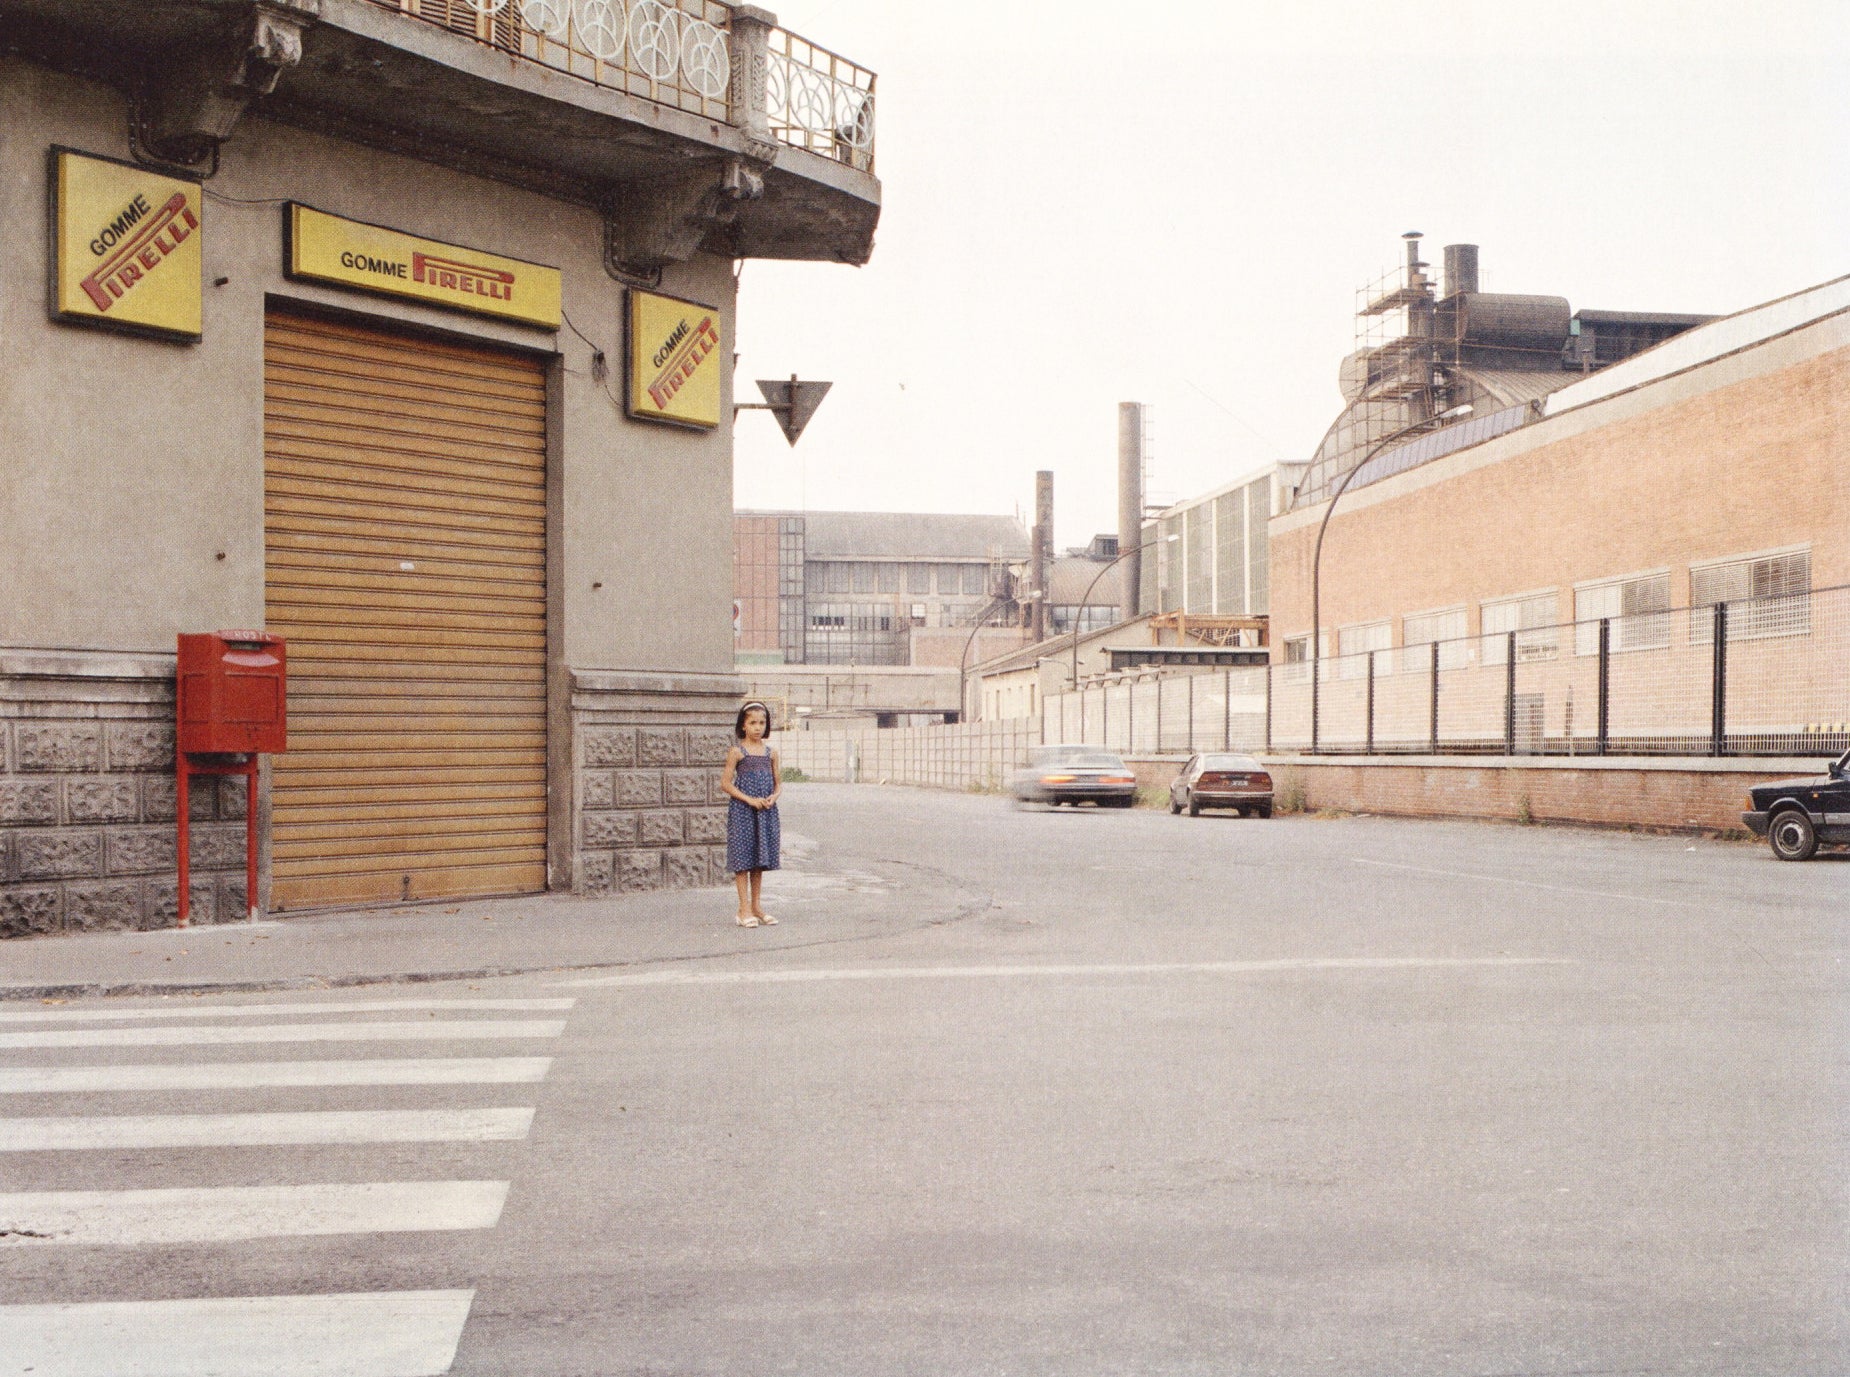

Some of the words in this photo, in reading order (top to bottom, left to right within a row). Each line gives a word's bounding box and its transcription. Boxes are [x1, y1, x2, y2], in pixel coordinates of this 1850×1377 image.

[80, 192, 199, 312] PIRELLI
[90, 193, 151, 257] GOMME
[341, 251, 407, 279] GOMME
[412, 251, 515, 301] PIRELLI
[648, 316, 719, 410] PIRELLI
[653, 318, 690, 369] GOMME
